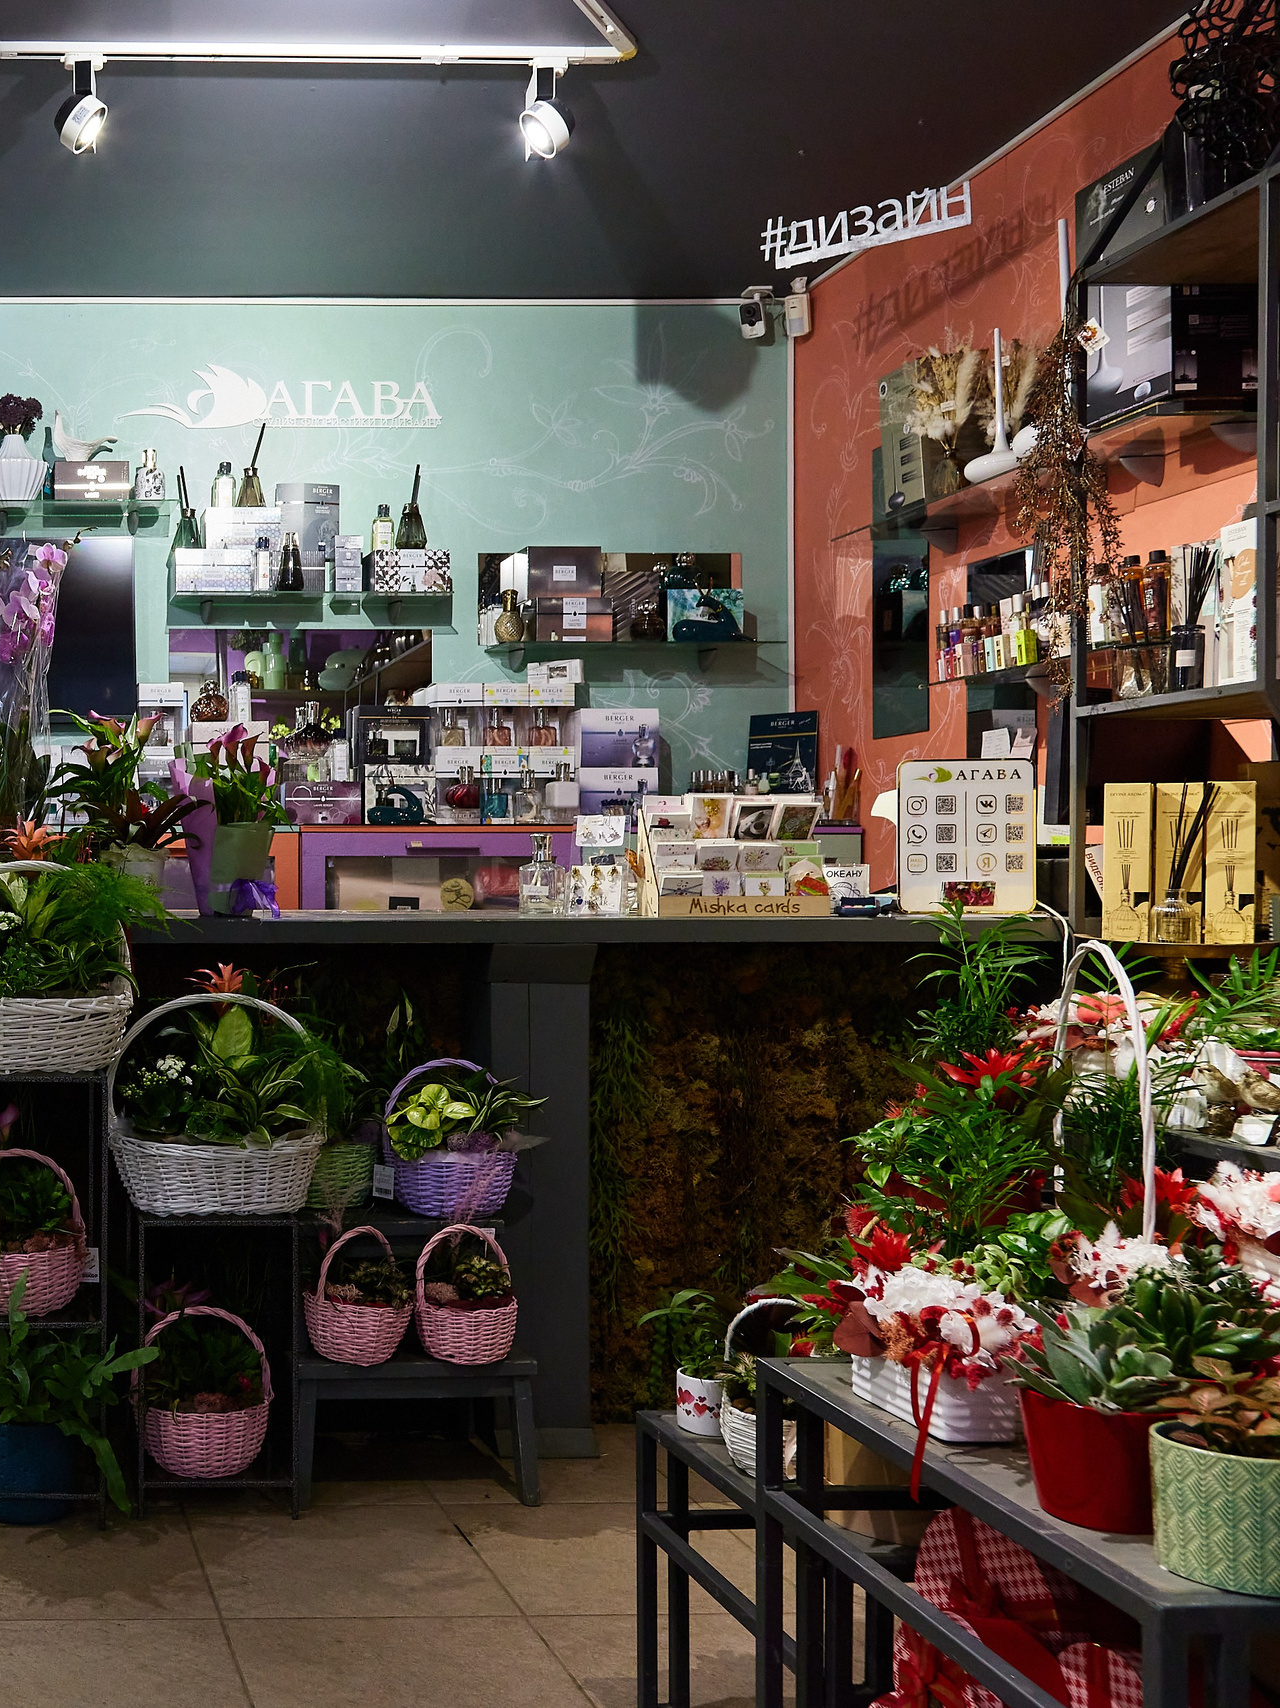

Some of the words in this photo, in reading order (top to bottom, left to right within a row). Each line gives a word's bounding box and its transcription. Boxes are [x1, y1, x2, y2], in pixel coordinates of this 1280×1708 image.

[1103, 167, 1135, 195] ESTEBAN
[760, 181, 972, 269] #дизайн
[261, 380, 442, 419] АГАВА
[955, 769, 1022, 780] АГАВА
[826, 869, 863, 879] ОКЕАНУ
[689, 897, 748, 916] Mishka
[754, 898, 801, 915] cards
